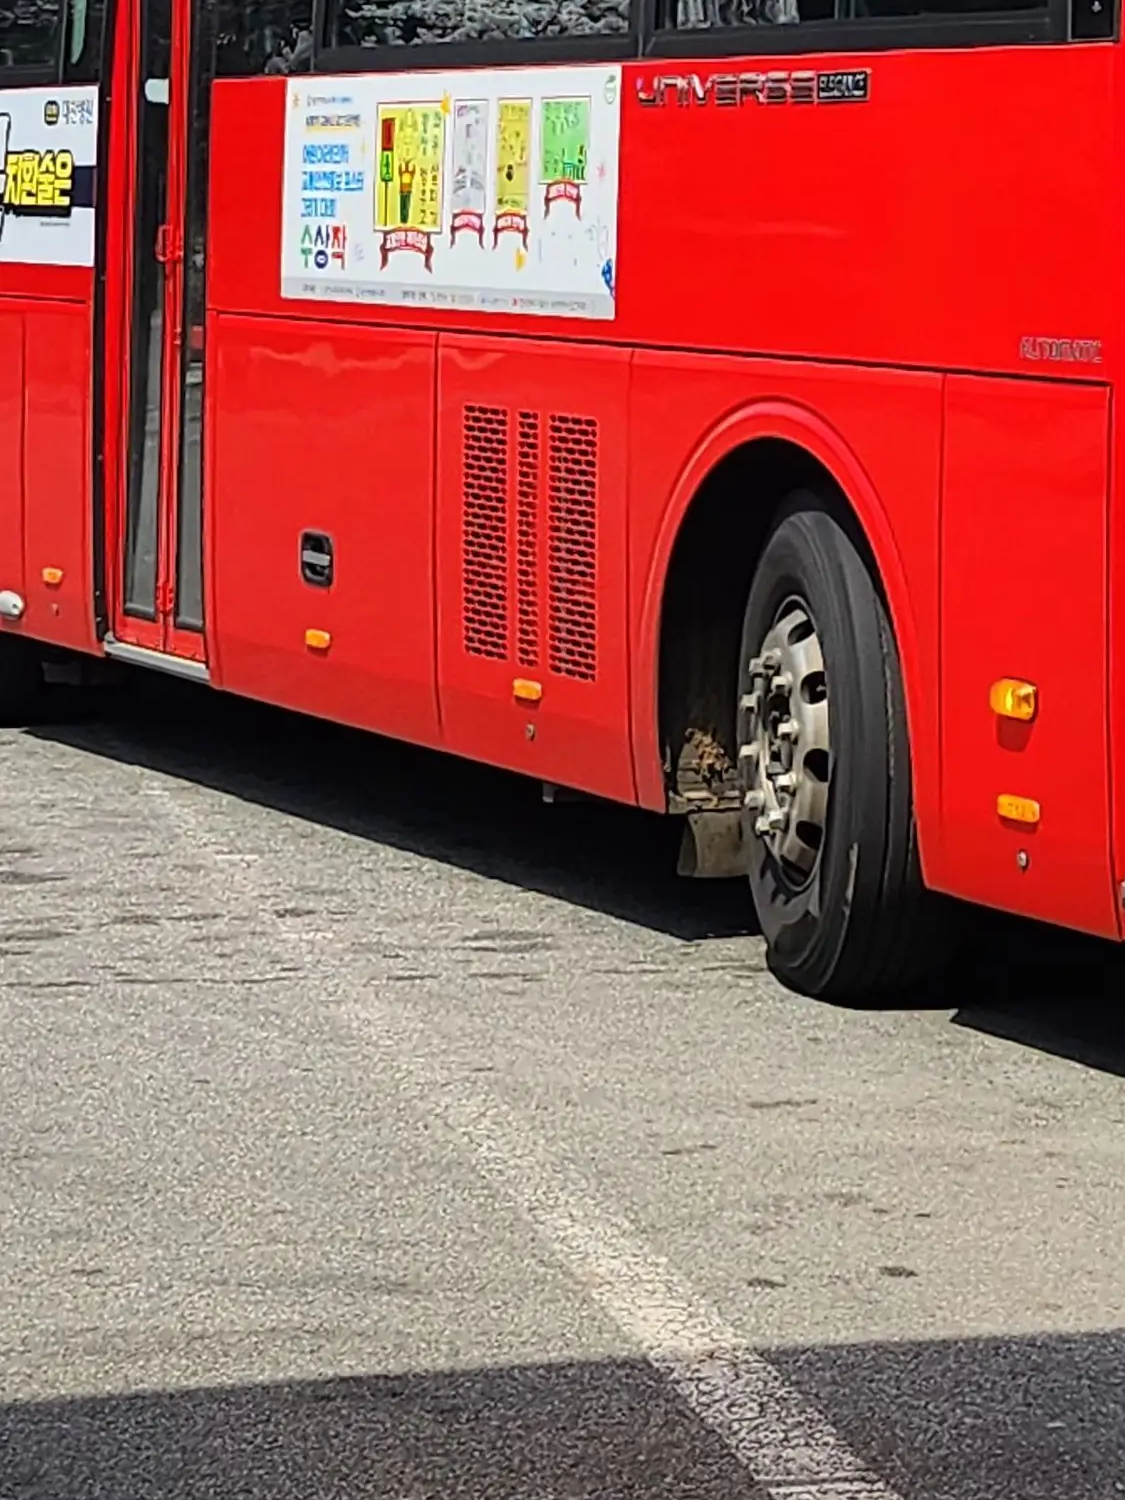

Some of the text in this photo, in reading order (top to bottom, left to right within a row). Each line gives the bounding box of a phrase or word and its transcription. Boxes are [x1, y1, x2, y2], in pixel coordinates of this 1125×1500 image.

[636, 71, 816, 105] UNIVERSE
[3, 152, 73, 206] 치환술은
[301, 224, 347, 270] 수상작
